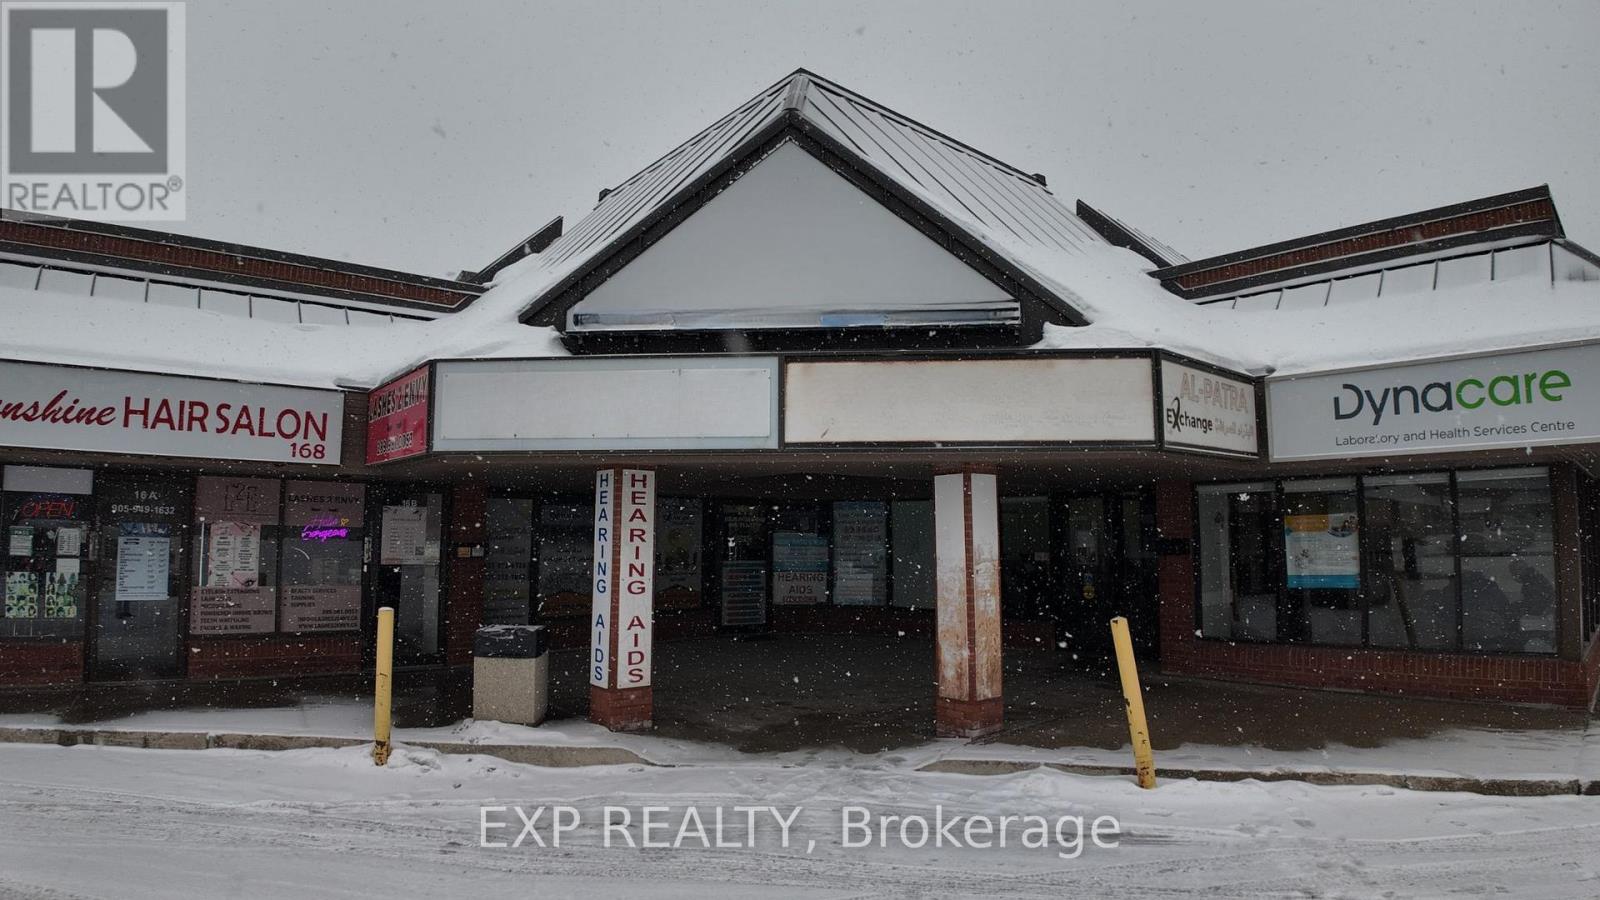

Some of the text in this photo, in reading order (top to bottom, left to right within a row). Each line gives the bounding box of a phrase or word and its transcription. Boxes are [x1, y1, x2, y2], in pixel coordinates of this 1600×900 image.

[1180, 372, 1249, 413] AL-PATRA
[1334, 369, 1572, 425] Dynacare
[0, 389, 328, 441] nshine HAIR SALON
[1403, 430, 1426, 442] and
[1429, 426, 1470, 439] Health
[1473, 423, 1527, 436] Services
[1530, 420, 1575, 433] Centre
[290, 442, 326, 459] 168
[21, 500, 76, 519] OPEN
[594, 473, 609, 681] HEARING AIDS
[626, 473, 648, 683] HEARING AIDS
[778, 572, 824, 582] HEARING
[788, 585, 813, 594] AIDS
